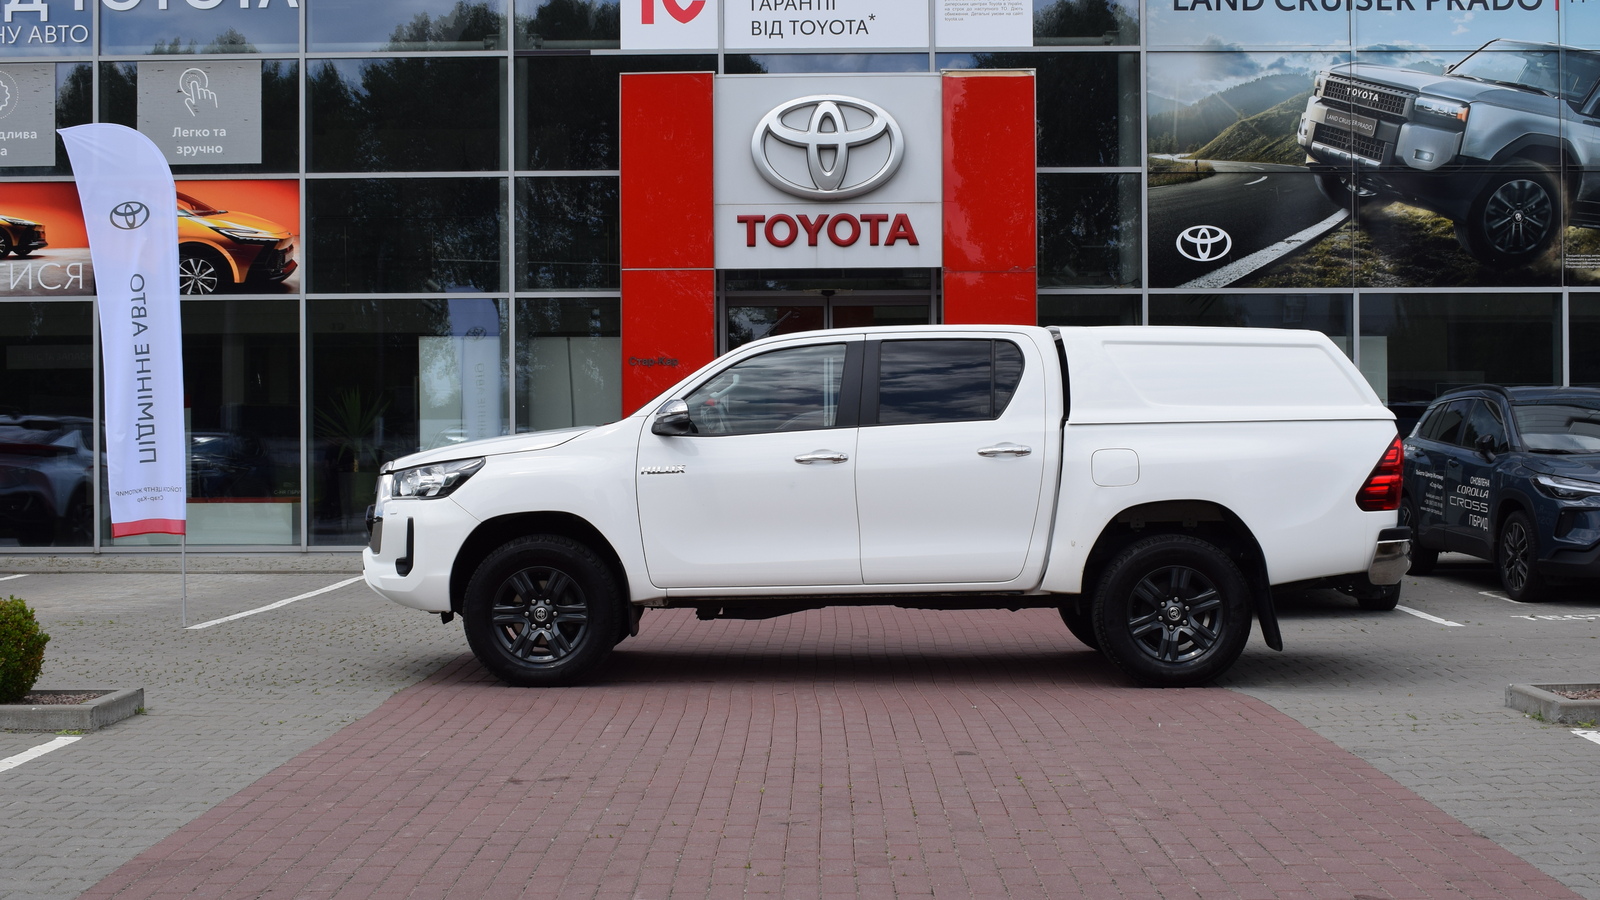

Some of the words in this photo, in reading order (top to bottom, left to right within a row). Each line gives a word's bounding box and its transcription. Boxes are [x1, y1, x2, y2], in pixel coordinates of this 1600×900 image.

[28, 24, 89, 43] АВТО
[751, 20, 783, 39] ВІД
[1346, 87, 1379, 102] TOYOTA
[1327, 114, 1338, 122] LAND
[172, 126, 210, 138] Легко
[213, 128, 227, 137] та
[176, 145, 223, 157] зручно
[737, 213, 920, 248] TOYOTA
[0, 262, 83, 290] ИСЯ
[629, 356, 679, 368] Стар-Кар
[1456, 484, 1490, 499] COROLLA
[1449, 495, 1489, 513] CROSS
